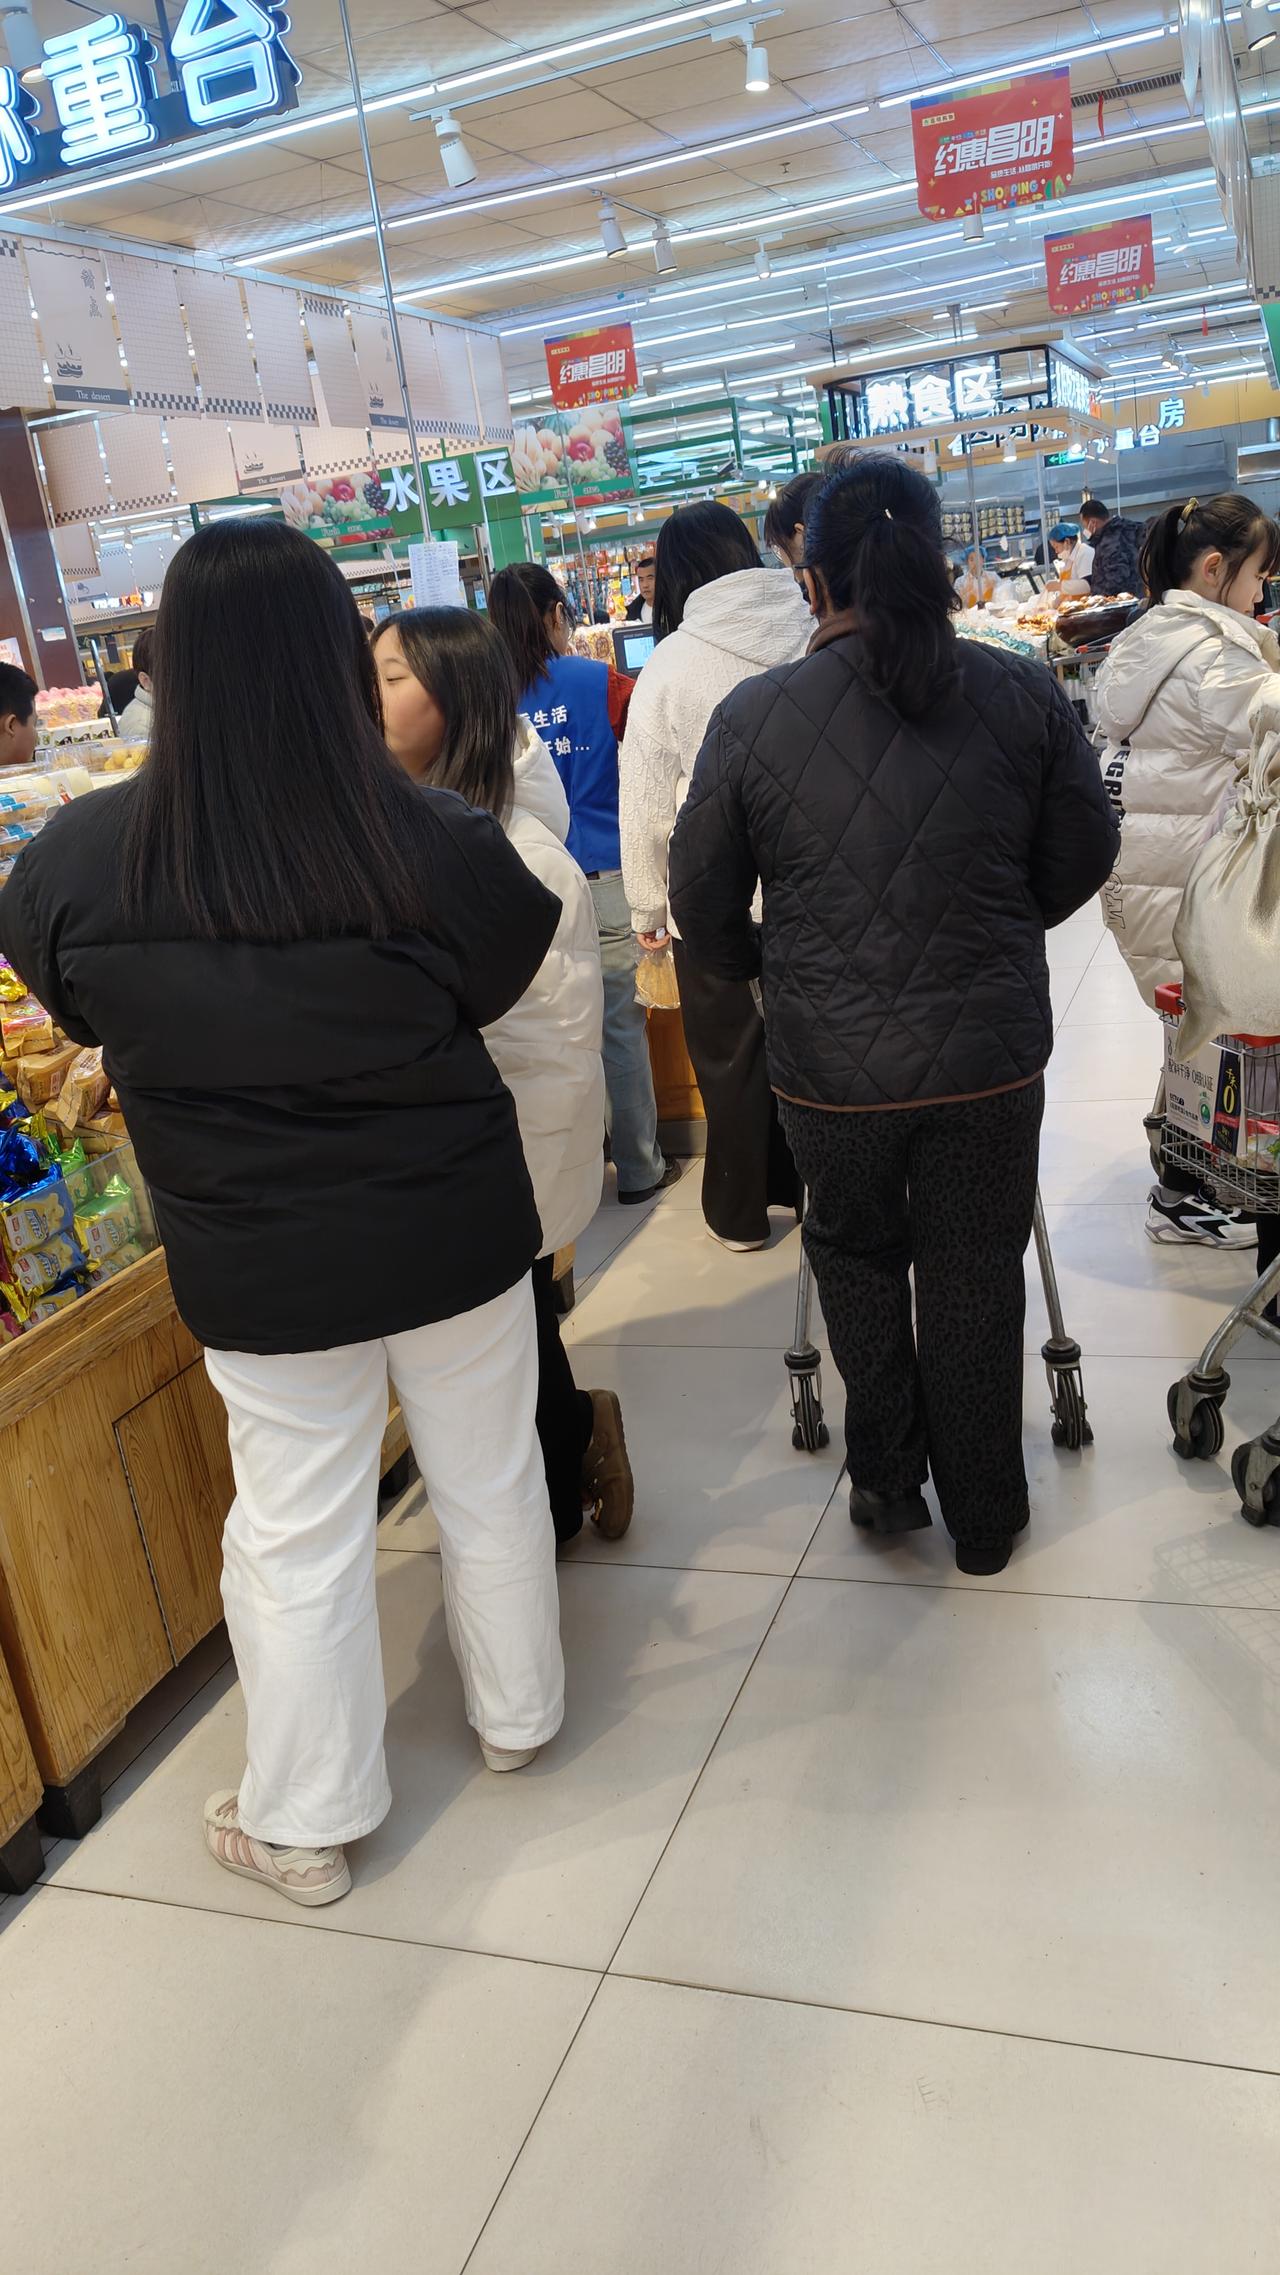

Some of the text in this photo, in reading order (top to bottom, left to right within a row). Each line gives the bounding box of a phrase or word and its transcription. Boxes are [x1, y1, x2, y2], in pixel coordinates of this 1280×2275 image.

[934, 115, 1055, 177] 约惠昌明
[1059, 244, 1142, 285] 约惠昌明
[560, 348, 626, 384] 约惠昌明
[867, 365, 997, 430] 熟食区
[1158, 398, 1185, 430] 房
[380, 450, 517, 512] 水果区
[519, 705, 568, 729] 生活
